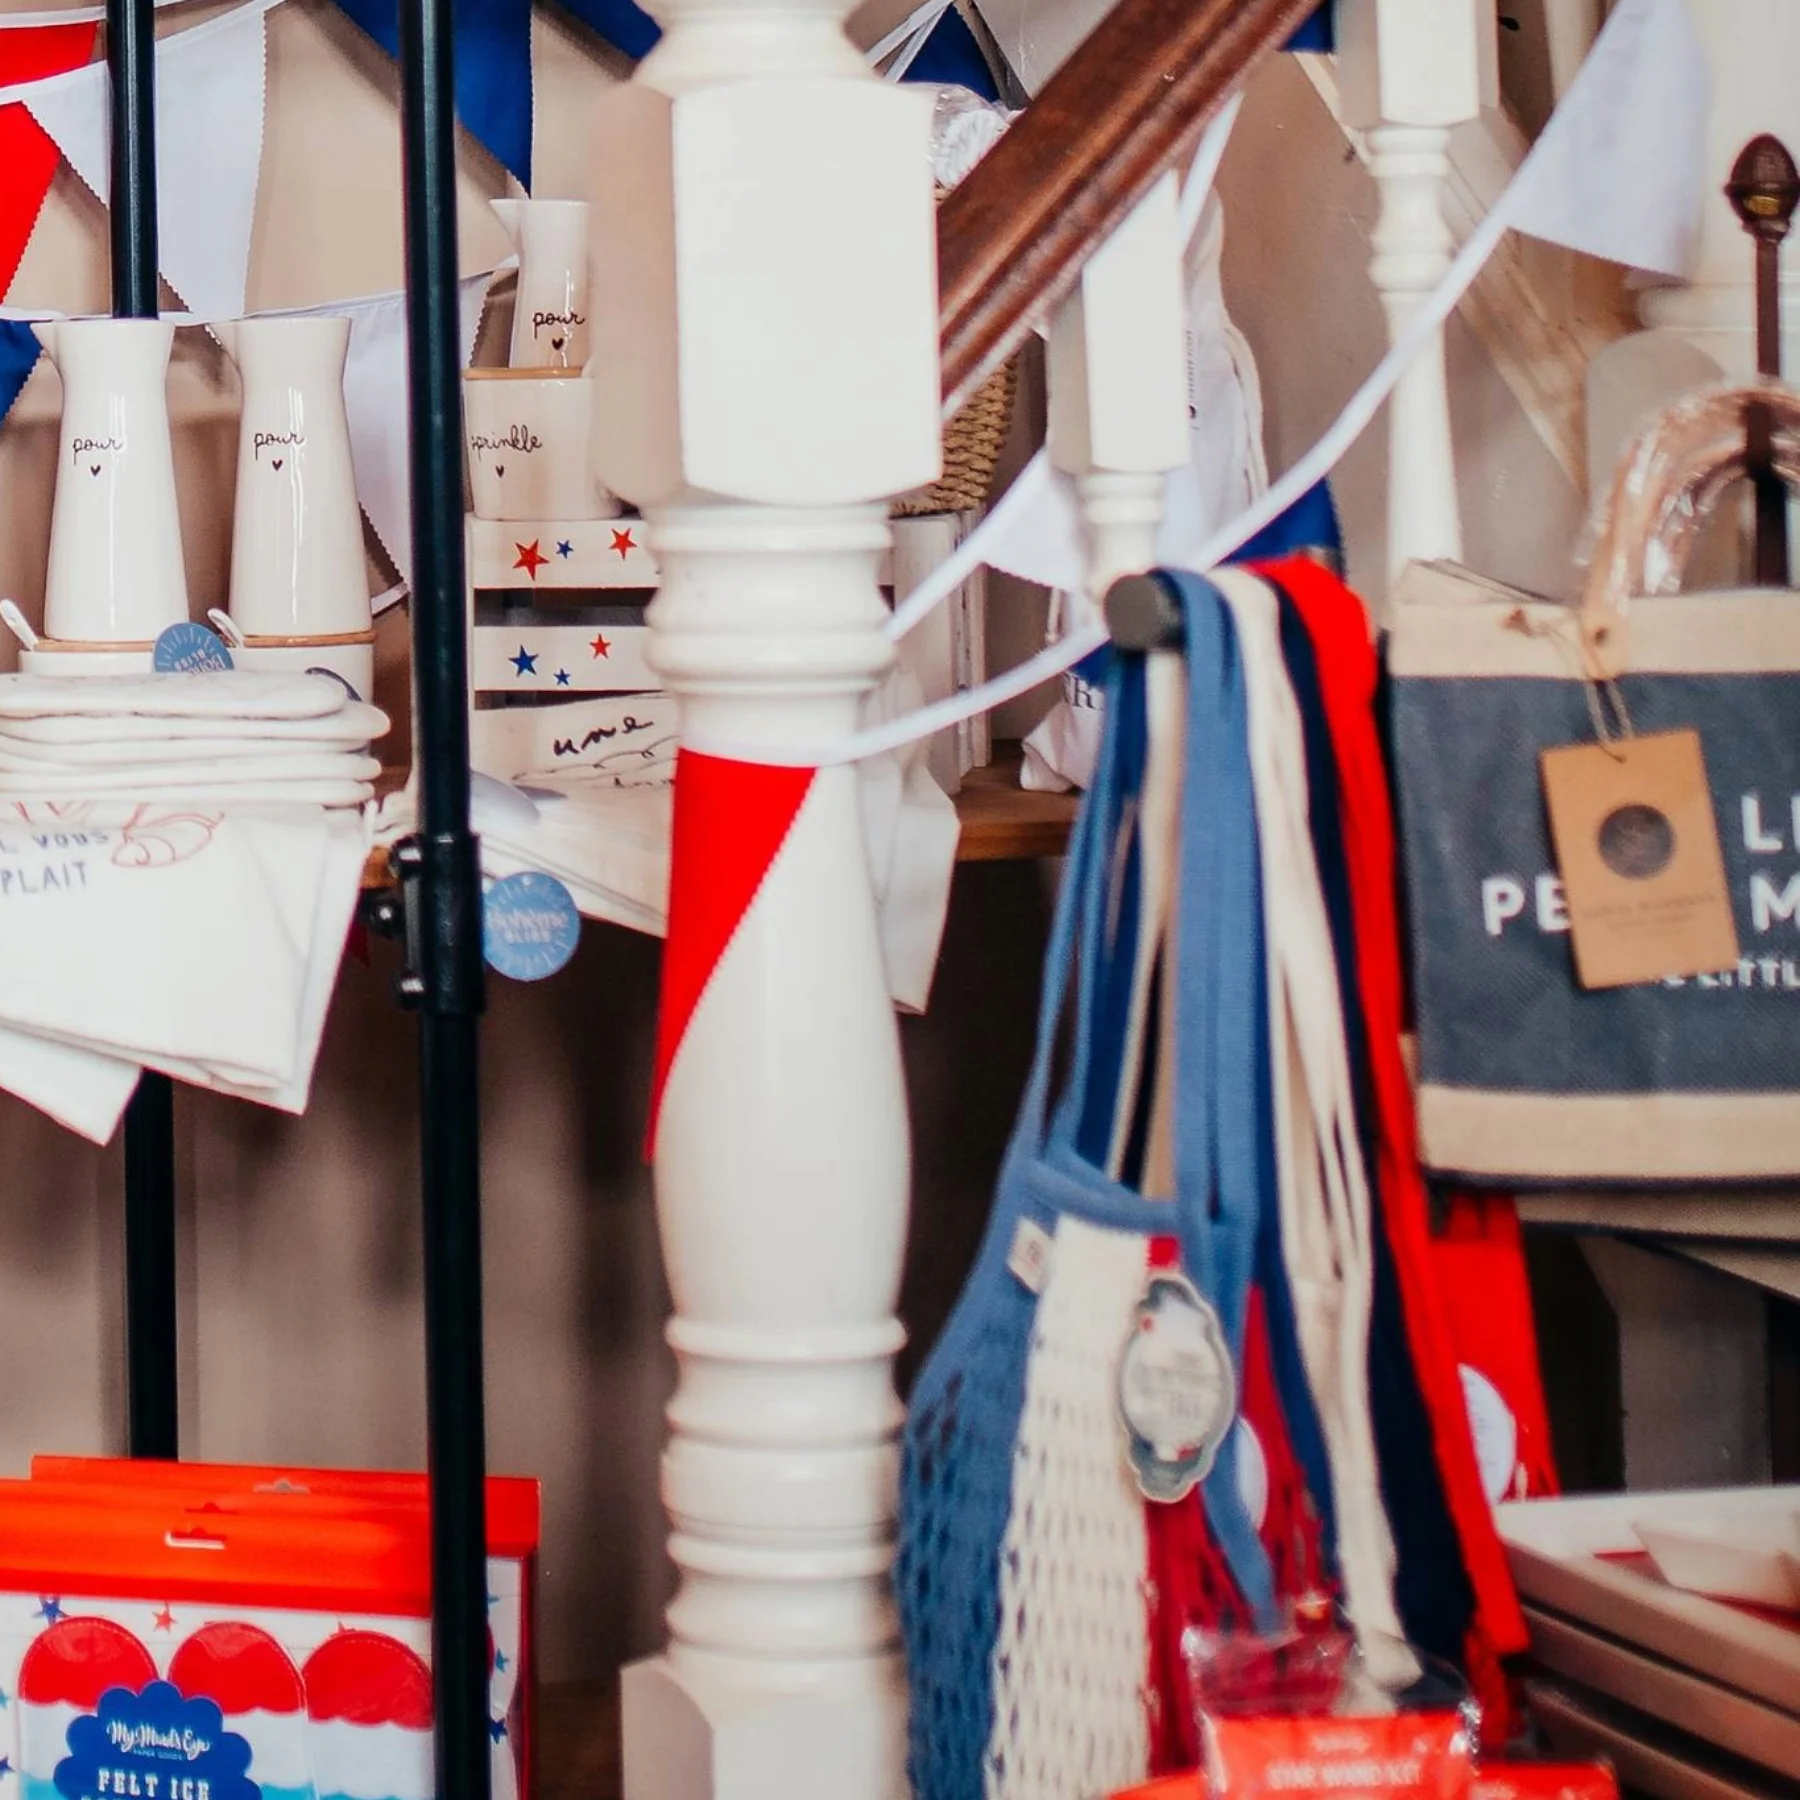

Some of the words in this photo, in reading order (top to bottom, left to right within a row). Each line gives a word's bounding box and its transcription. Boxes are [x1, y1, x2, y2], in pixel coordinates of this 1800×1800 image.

[532, 311, 586, 340] pour
[73, 436, 124, 466] pour
[253, 431, 305, 461] pour
[32, 831, 111, 852] VOUS
[0, 860, 90, 894] PLAIT
[106, 1719, 135, 1753] My
[182, 1728, 211, 1761] Eye
[98, 1768, 159, 1798] FELT
[170, 1776, 211, 1800] ICE
[1268, 1759, 1316, 1789] STAR
